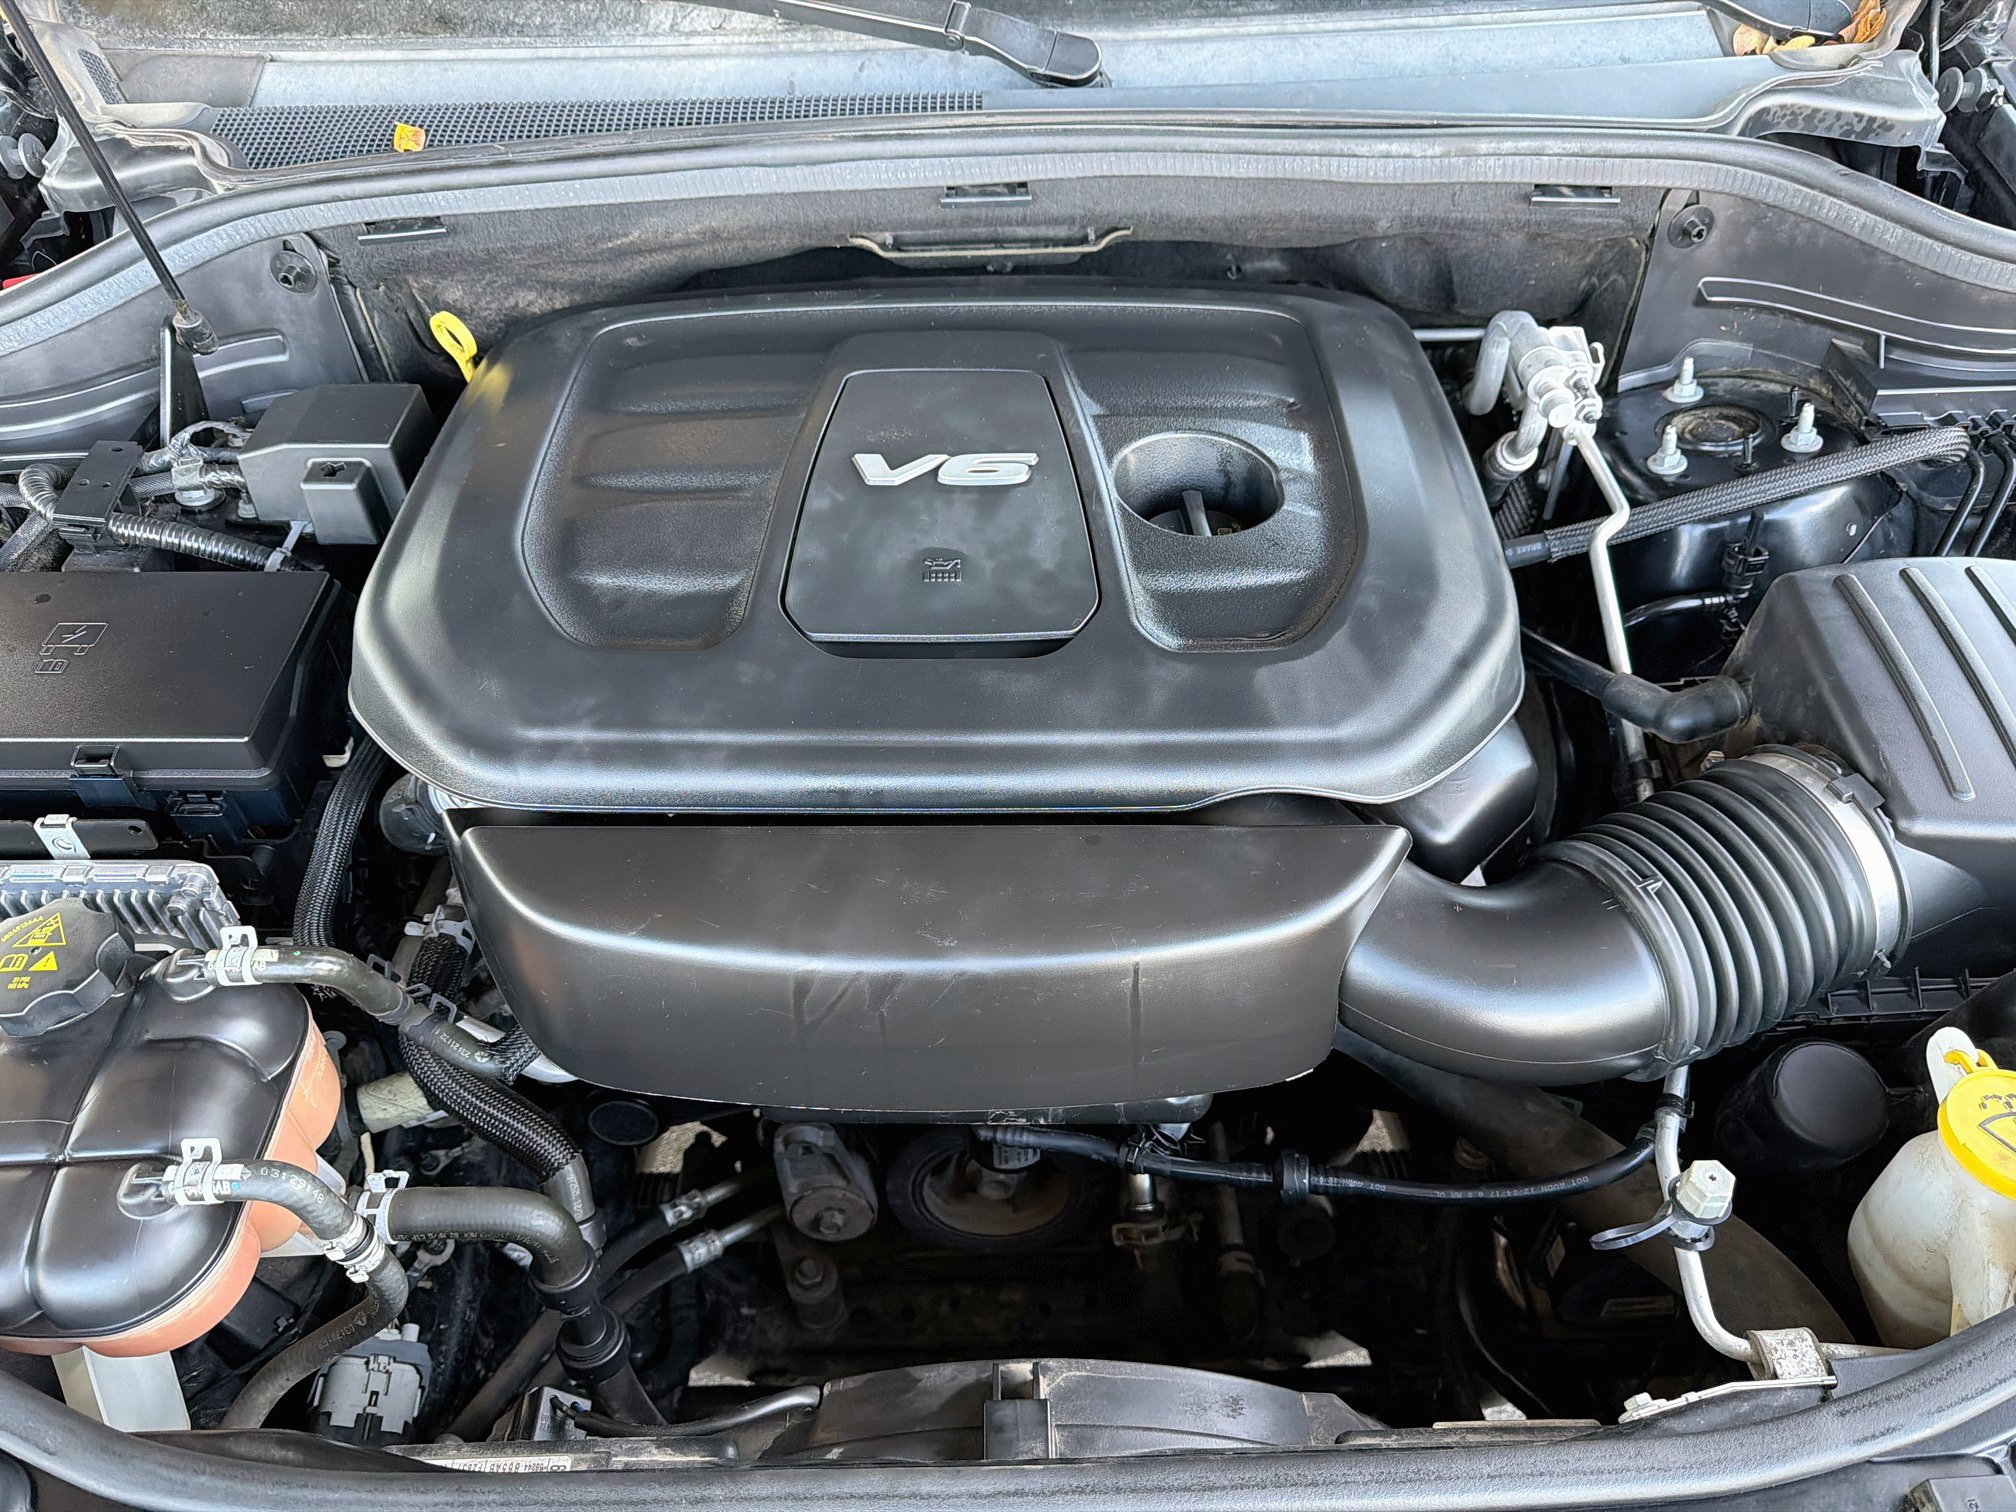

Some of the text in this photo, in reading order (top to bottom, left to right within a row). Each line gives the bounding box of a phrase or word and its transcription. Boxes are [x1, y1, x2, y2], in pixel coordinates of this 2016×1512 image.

[852, 453, 1039, 486] V6
[1515, 542, 1542, 555] BRAKE
[1571, 1175, 1589, 1185] DOT
